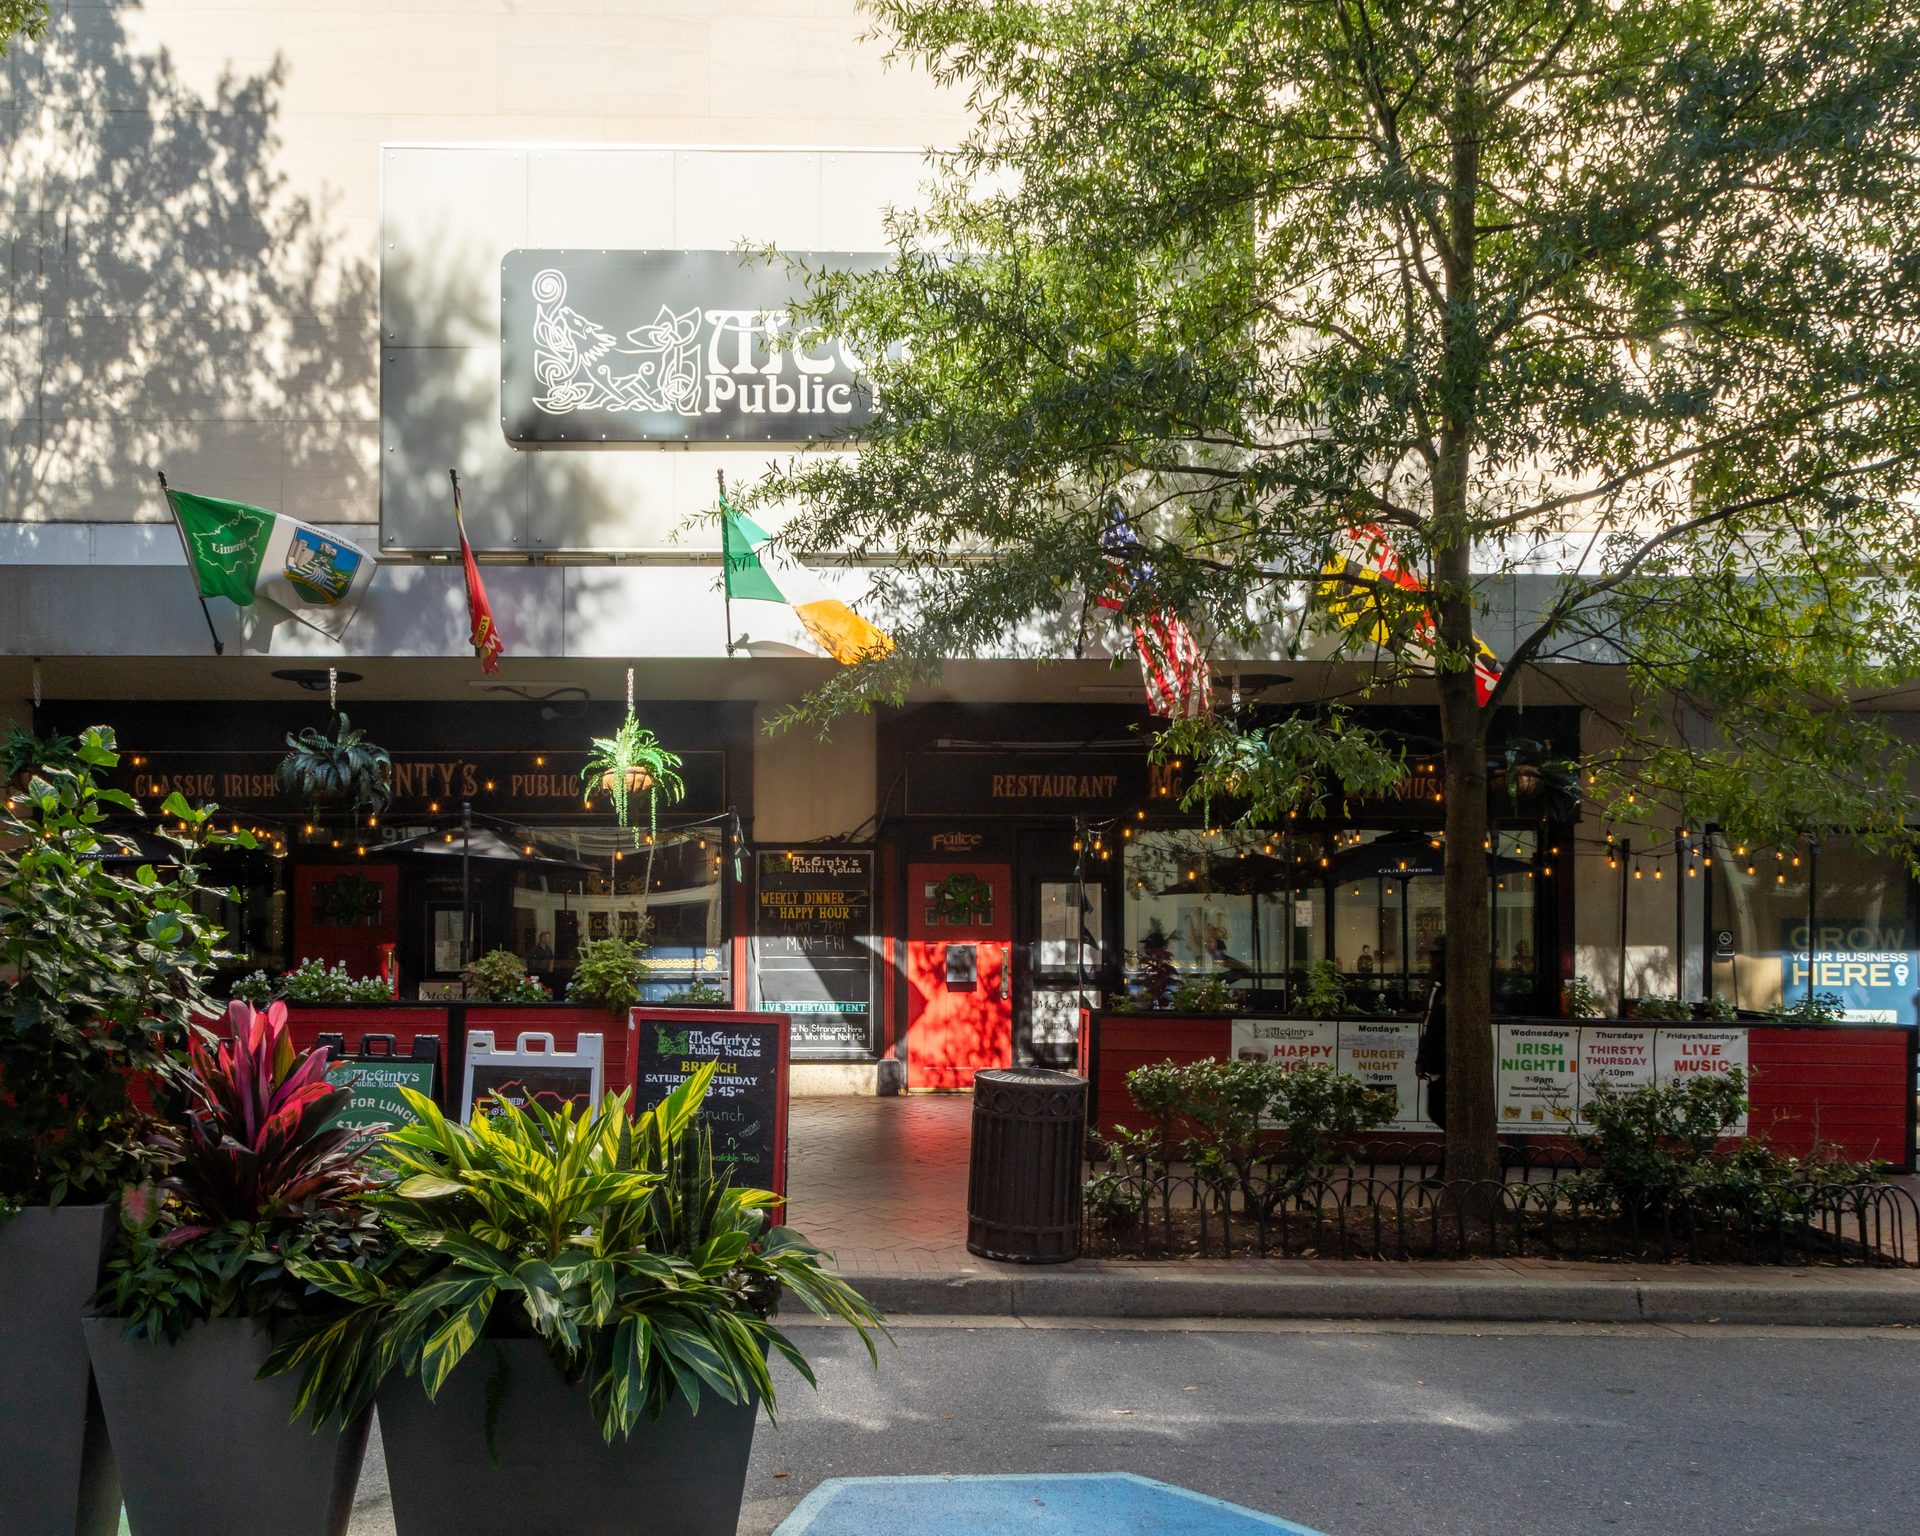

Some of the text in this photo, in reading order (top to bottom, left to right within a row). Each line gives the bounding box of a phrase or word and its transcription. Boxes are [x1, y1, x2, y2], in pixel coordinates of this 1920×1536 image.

[704, 374, 853, 414] Public
[394, 759, 479, 798] NTY'S
[511, 773, 580, 797] PUBLIC
[991, 774, 1118, 798] RESTAURANT
[1148, 764, 1183, 798] Mc
[134, 774, 277, 797] CLASSIC IRISH
[792, 855, 859, 867] McGinty's
[792, 865, 825, 874] Public
[760, 892, 844, 905] WEEKLY DINNER
[779, 906, 850, 919] HAPPY HOUR
[1790, 926, 1906, 951] GROW
[1791, 952, 1909, 963] YOUR BUSINESS
[1792, 962, 1892, 987] HERE
[760, 1002, 866, 1013] LIVE ENTERTAINMENT
[799, 1024, 809, 1033] No
[811, 1023, 847, 1035] Strangers
[1358, 1024, 1400, 1035] Mondays
[1510, 1028, 1570, 1039] Wednesdays
[688, 1030, 761, 1048] McGinty's
[804, 1033, 818, 1041] Who
[837, 1033, 851, 1041] Not
[1595, 1031, 1645, 1041] Thursdays
[1666, 1032, 1739, 1041] Fridays/Saturdays
[688, 1044, 720, 1056] Public
[1273, 1044, 1333, 1058] HAPPY
[1352, 1049, 1405, 1059] BURGER
[1516, 1042, 1564, 1056] IRISH
[1588, 1045, 1645, 1055] THIRSTY
[1682, 1043, 1722, 1056] LIVE
[680, 1060, 737, 1074] BRNCH
[1358, 1061, 1399, 1071] NIGHT
[1501, 1058, 1557, 1072] NIGHT
[1585, 1056, 1648, 1066] THURSDAY
[1674, 1060, 1729, 1072] MUSIC
[352, 1069, 420, 1085] McGinty's
[645, 1073, 758, 1086] SATURD SUNDAY
[1600, 1068, 1635, 1078] 7-10pm
[350, 1097, 420, 1123] FOR LUNCH
[697, 1105, 745, 1122] Brunch
